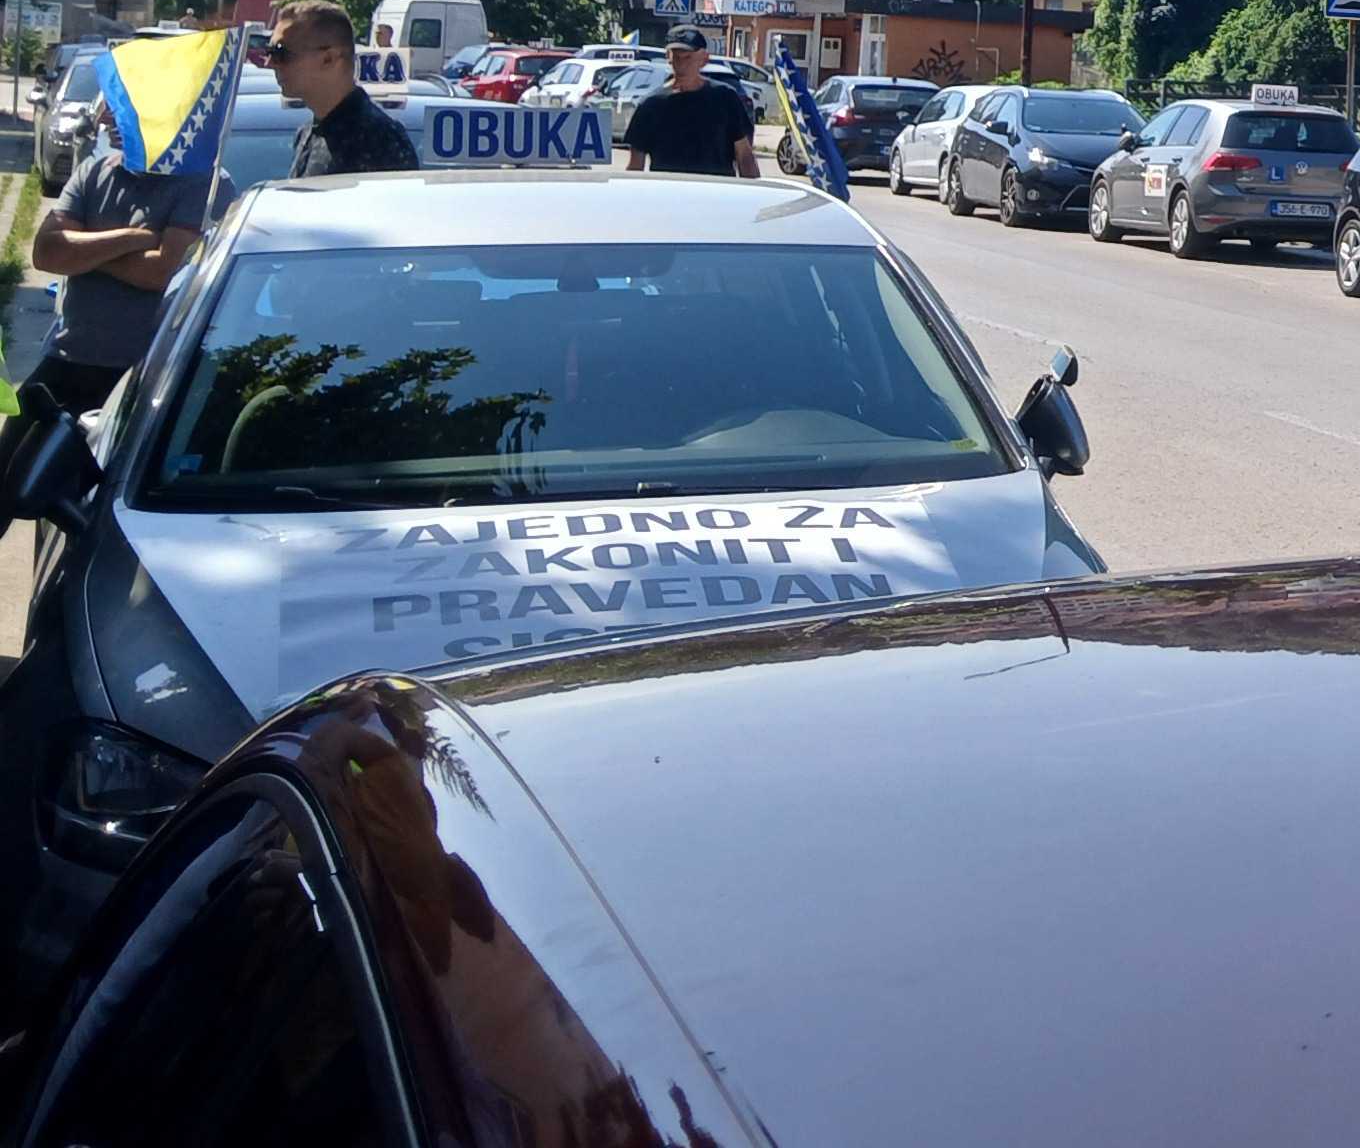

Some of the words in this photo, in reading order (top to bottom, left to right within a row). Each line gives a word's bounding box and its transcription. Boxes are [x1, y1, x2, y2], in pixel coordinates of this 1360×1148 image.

[1256, 88, 1295, 101] OBUKA
[432, 110, 605, 159] OBUKA
[336, 508, 754, 553] ZAJEDNO
[784, 505, 897, 530] ZA
[393, 537, 802, 584] ZAKONIT
[832, 537, 858, 563] I
[372, 573, 893, 633] PRAVEDAN
